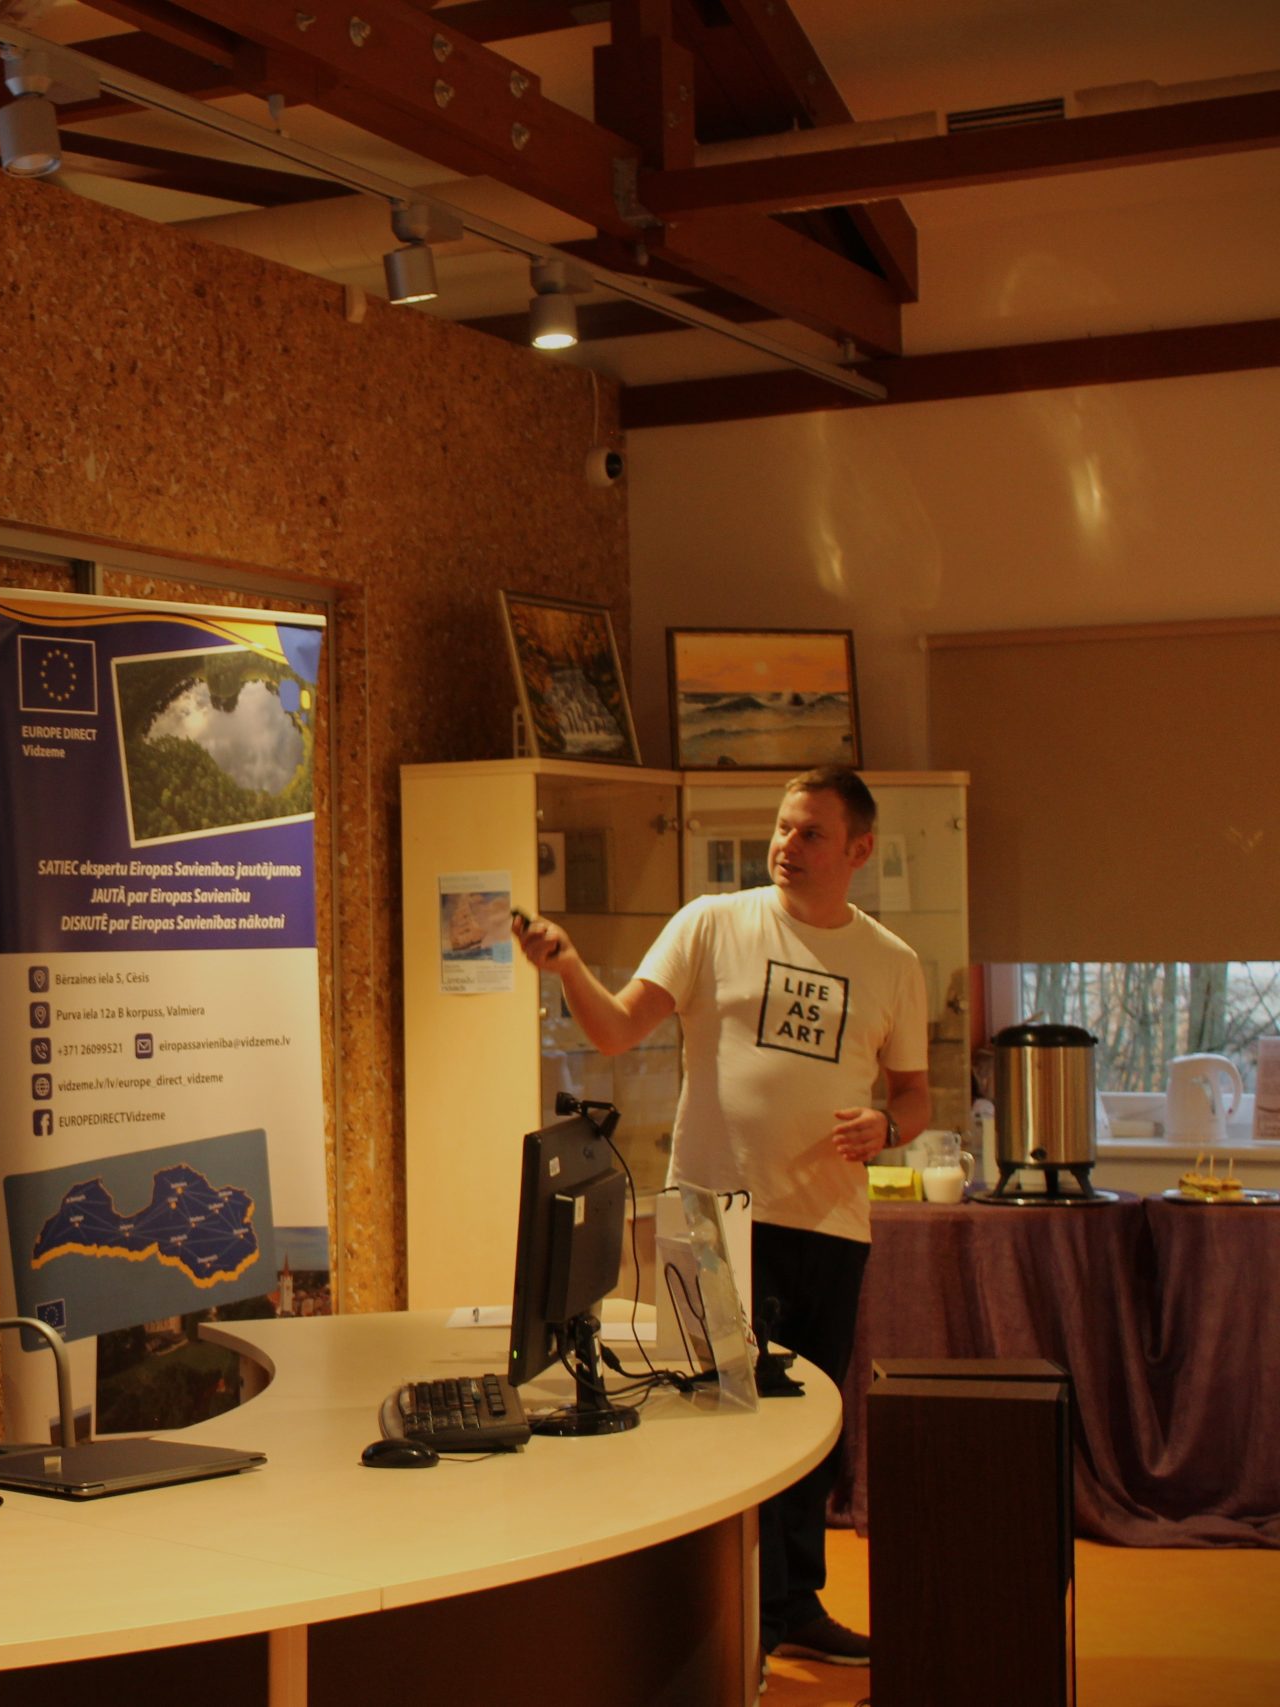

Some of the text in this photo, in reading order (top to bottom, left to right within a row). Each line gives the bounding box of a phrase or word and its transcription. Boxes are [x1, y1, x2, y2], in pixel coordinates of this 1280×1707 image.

[21, 726, 97, 741] EUROPE DIRECT
[22, 744, 66, 758] Vidzeme
[38, 860, 302, 880] SATIEC ekspertu Eiropas Savienības jautājumos
[90, 885, 250, 906] JAUTĀ par Eiropas Savienību
[61, 913, 286, 934] DISKUTĒ par Eiropas Savienības nākotni
[55, 973, 96, 985] Bērzaines
[98, 973, 114, 985] iela
[126, 972, 150, 983] Cēsis
[784, 977, 829, 1001] LIFE
[56, 1006, 205, 1021] Purva iela 12a B korpuss, Valmiera
[787, 1001, 820, 1022] AS
[776, 1020, 825, 1045] ART
[57, 1043, 123, 1057] +371 26099521
[59, 1110, 166, 1128] EUROPEDIRECTVidzeme
